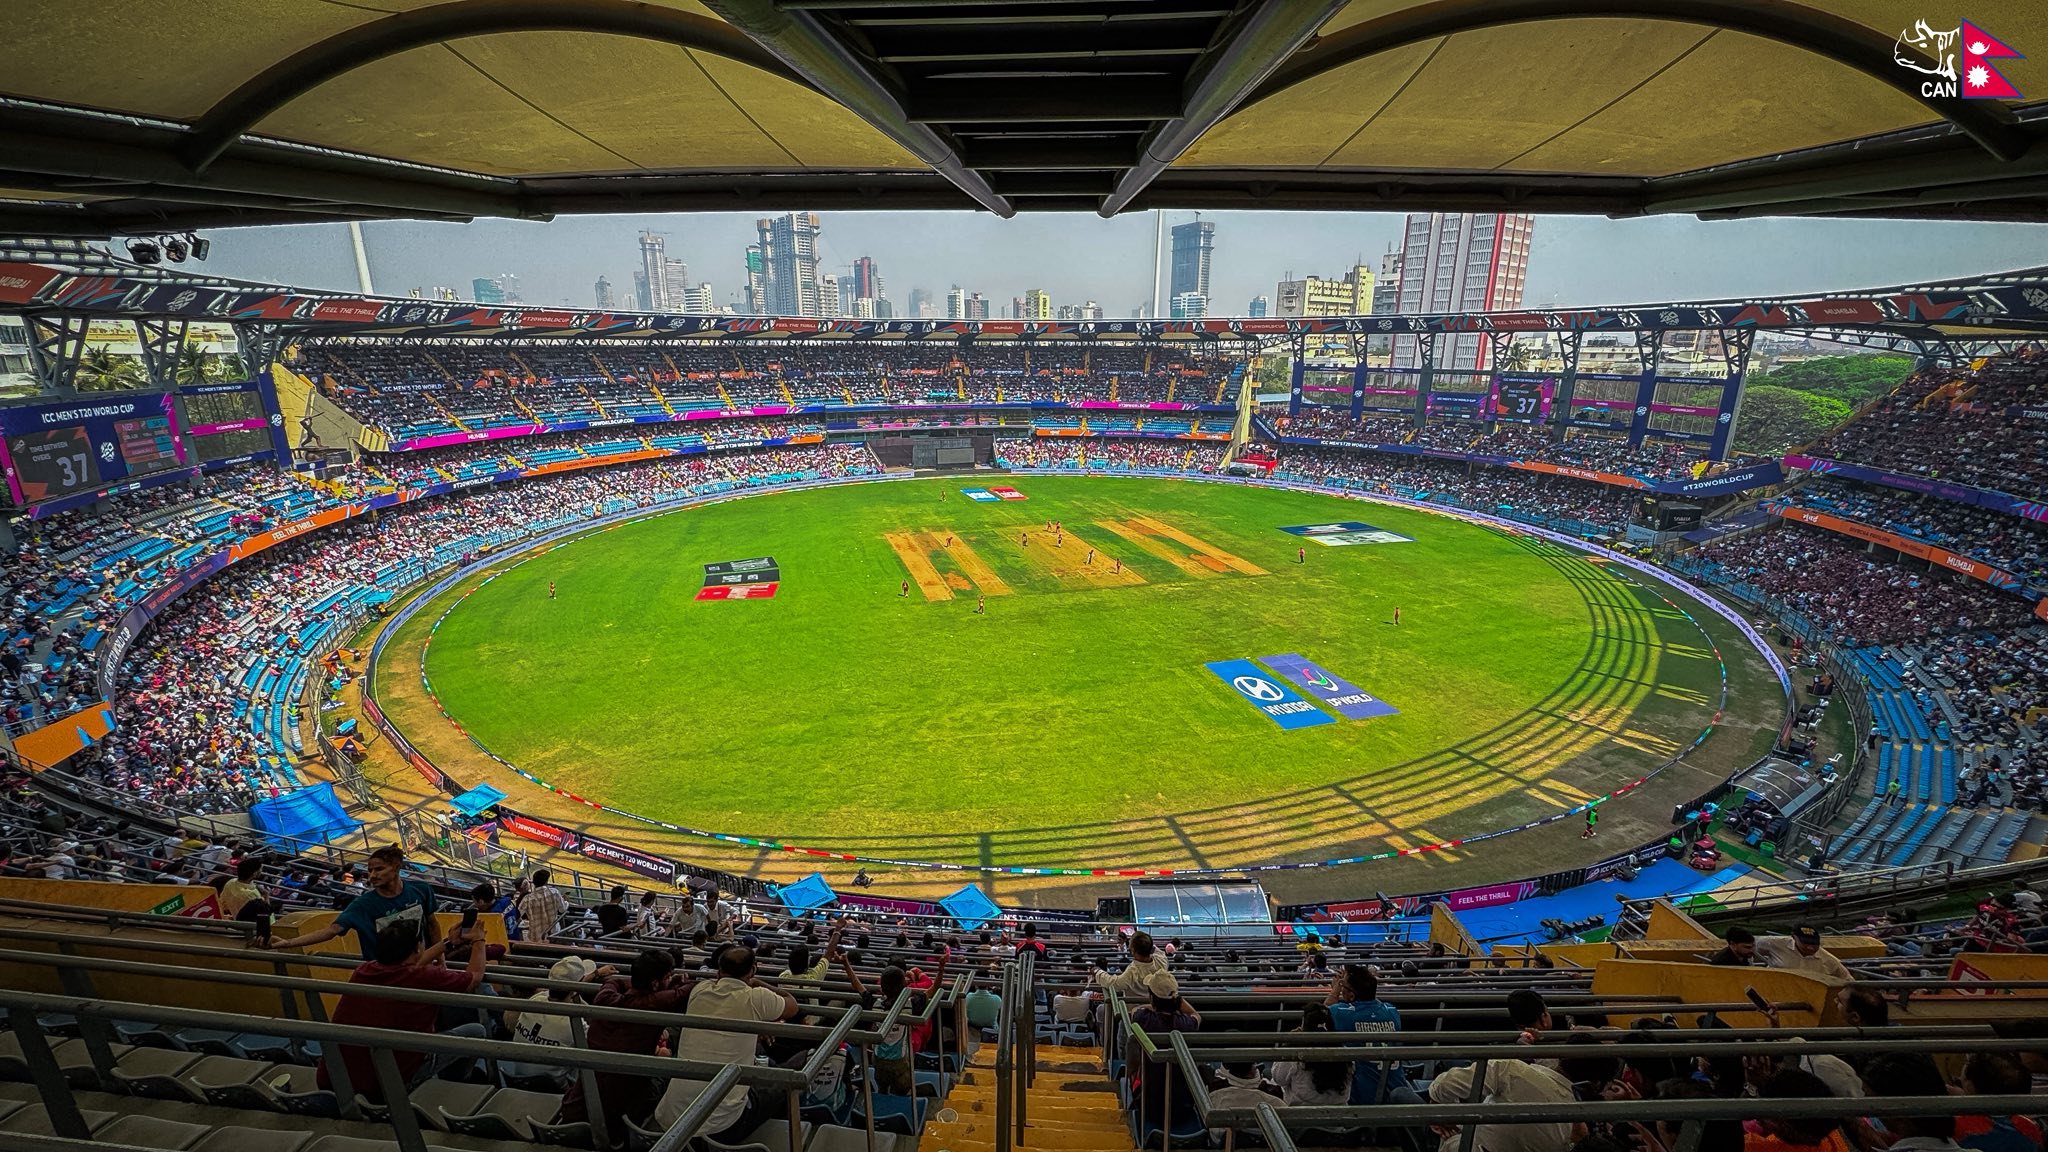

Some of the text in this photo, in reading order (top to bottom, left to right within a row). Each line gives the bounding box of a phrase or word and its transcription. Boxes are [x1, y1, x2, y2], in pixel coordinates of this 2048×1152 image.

[354, 308, 376, 316] THRILL
[1824, 307, 1858, 316] MUMBAI
[1516, 398, 1536, 414] 37
[41, 404, 134, 424] ICC MEN'S T20 WORLD CUP
[56, 453, 88, 486] 37
[1581, 470, 1599, 479] THRILL
[453, 476, 495, 488] #T20WORLDCUP
[1683, 473, 1754, 491] #T20WORLDCUP
[272, 520, 316, 540] FEEL THE THRILL
[1947, 556, 1975, 573] MUMBAI
[1326, 694, 1373, 707] DP WORLD
[1263, 701, 1316, 716] HYUNDAI
[515, 822, 562, 843] T20WORLDCUP.COM
[1655, 848, 1666, 856] CUP
[607, 850, 624, 860] MEN'S
[625, 855, 635, 864] T20
[637, 859, 658, 871] WORLD
[659, 866, 672, 875] CUP
[1489, 892, 1510, 900] THRILL
[161, 900, 180, 914] EXIT
